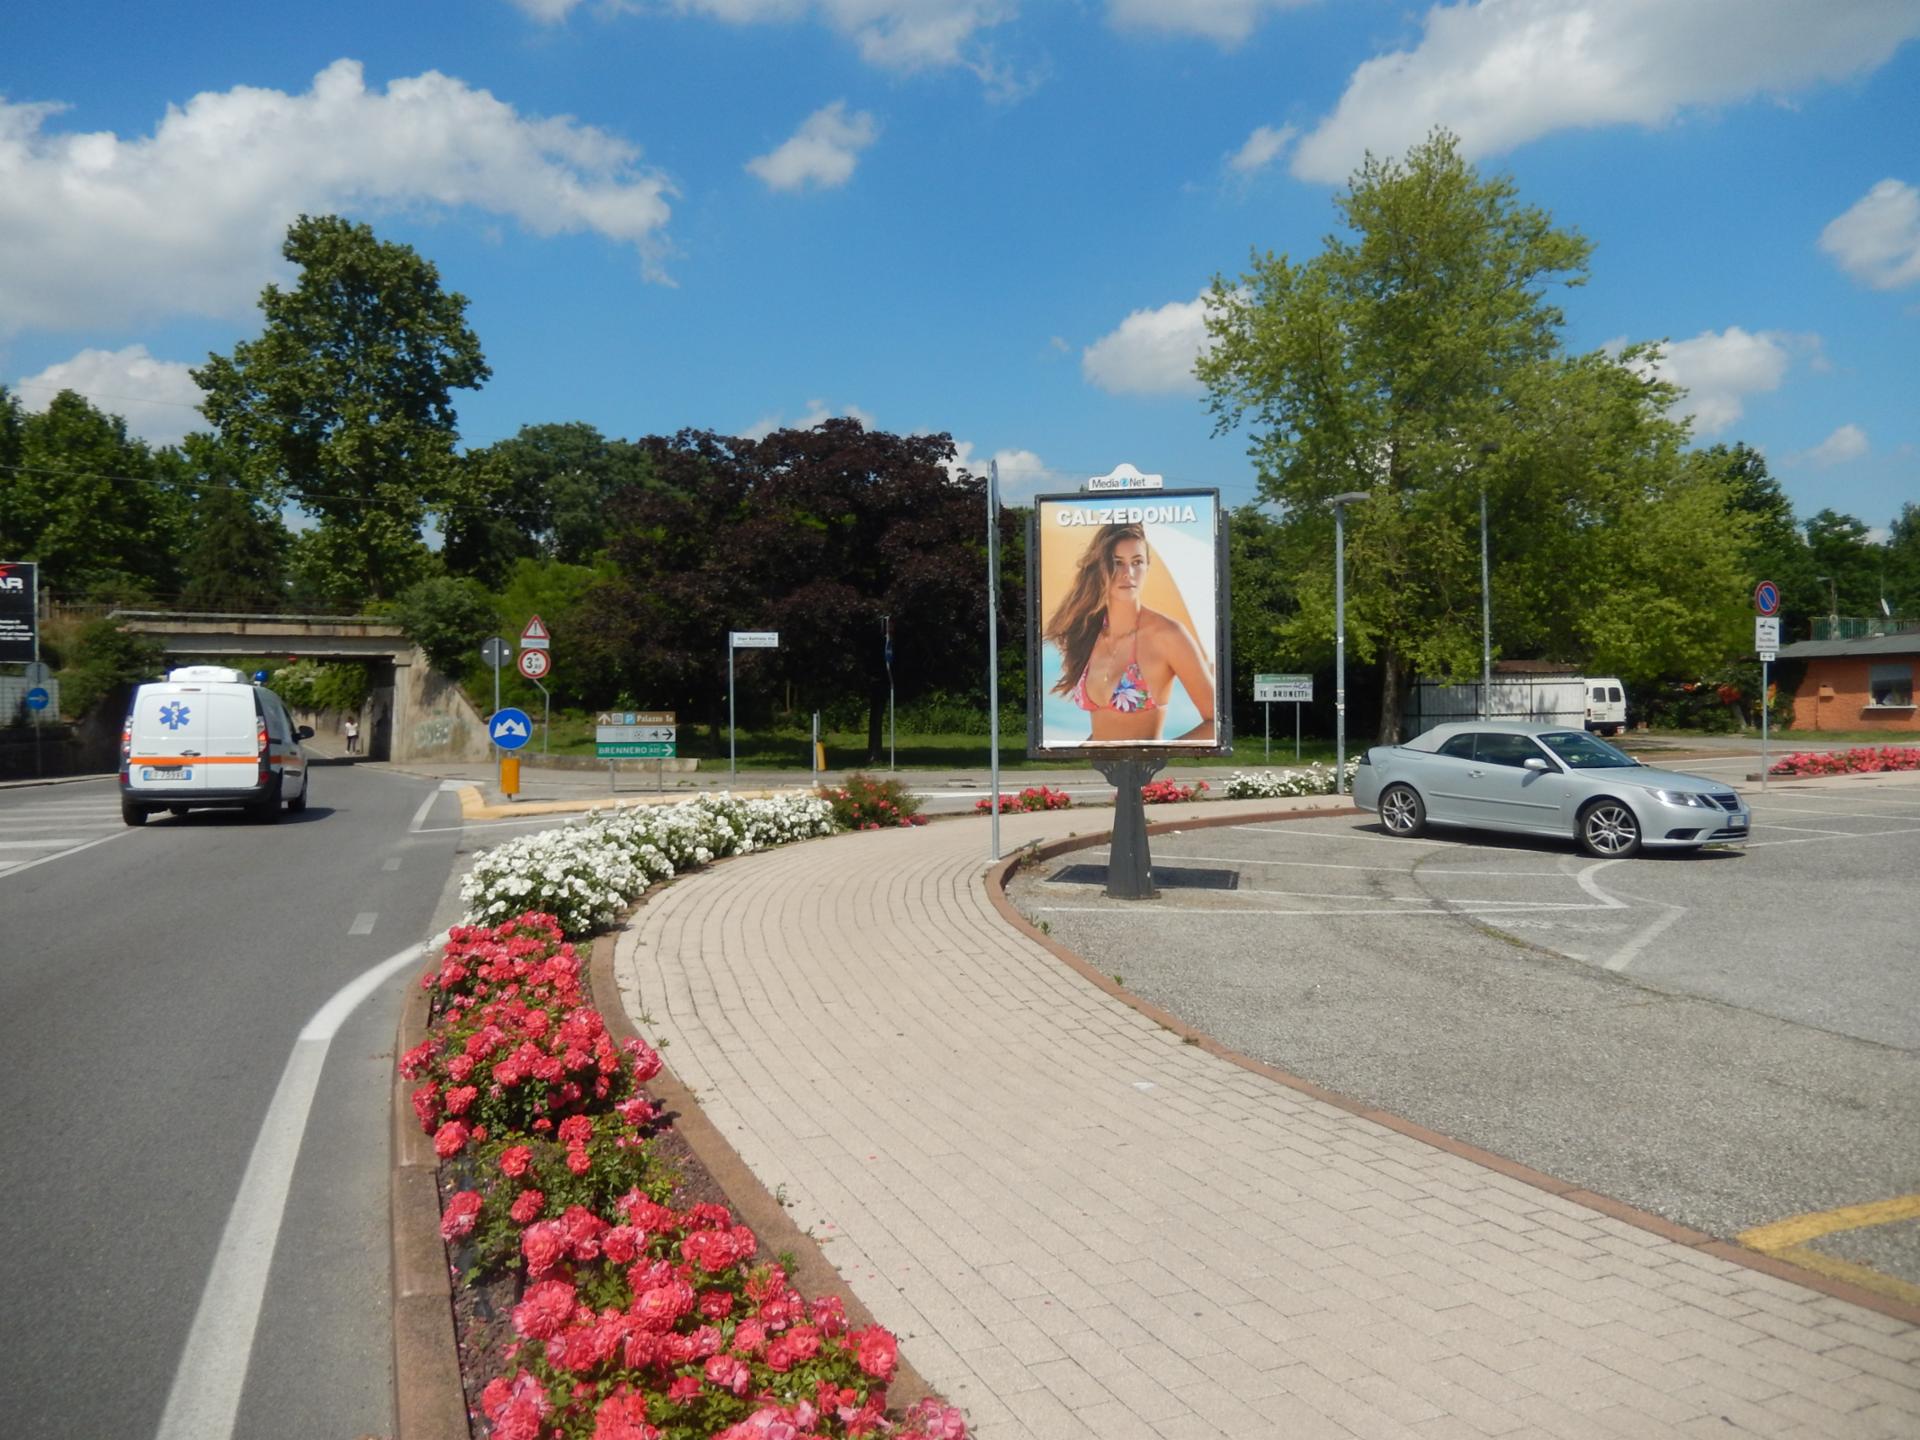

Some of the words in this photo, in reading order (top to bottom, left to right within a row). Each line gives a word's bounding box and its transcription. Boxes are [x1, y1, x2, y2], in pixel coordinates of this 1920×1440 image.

[1092, 479, 1120, 489] Media
[1129, 477, 1146, 488] Net
[1056, 505, 1199, 527] CALZEDONIA
[598, 746, 648, 755] BRENNERO
